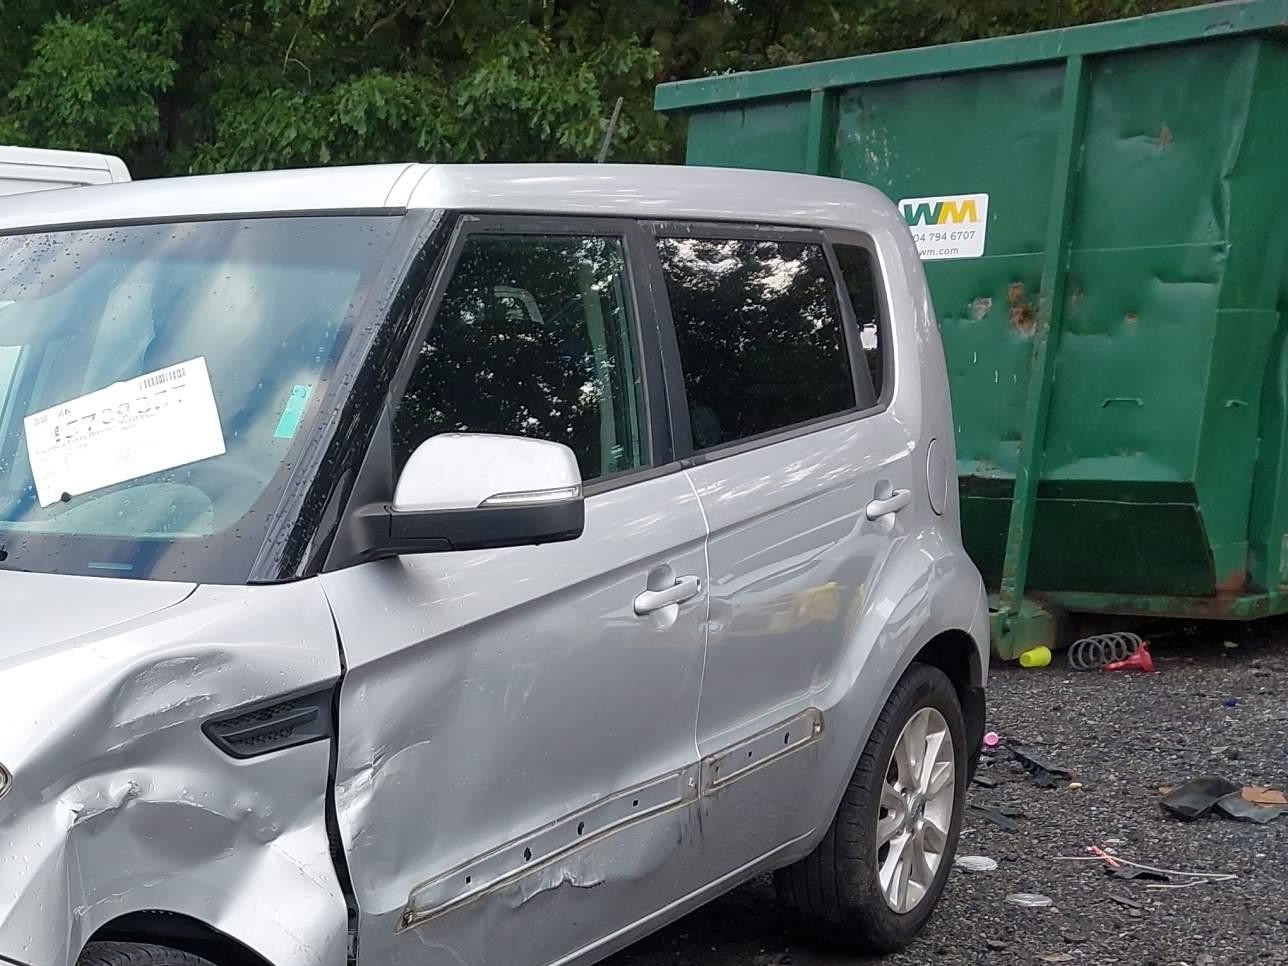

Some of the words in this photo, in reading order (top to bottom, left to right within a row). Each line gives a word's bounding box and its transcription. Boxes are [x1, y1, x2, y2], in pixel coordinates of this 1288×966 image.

[903, 199, 978, 226] WM
[913, 232, 926, 242] 04
[928, 231, 947, 242] 794
[950, 230, 976, 241] 6707
